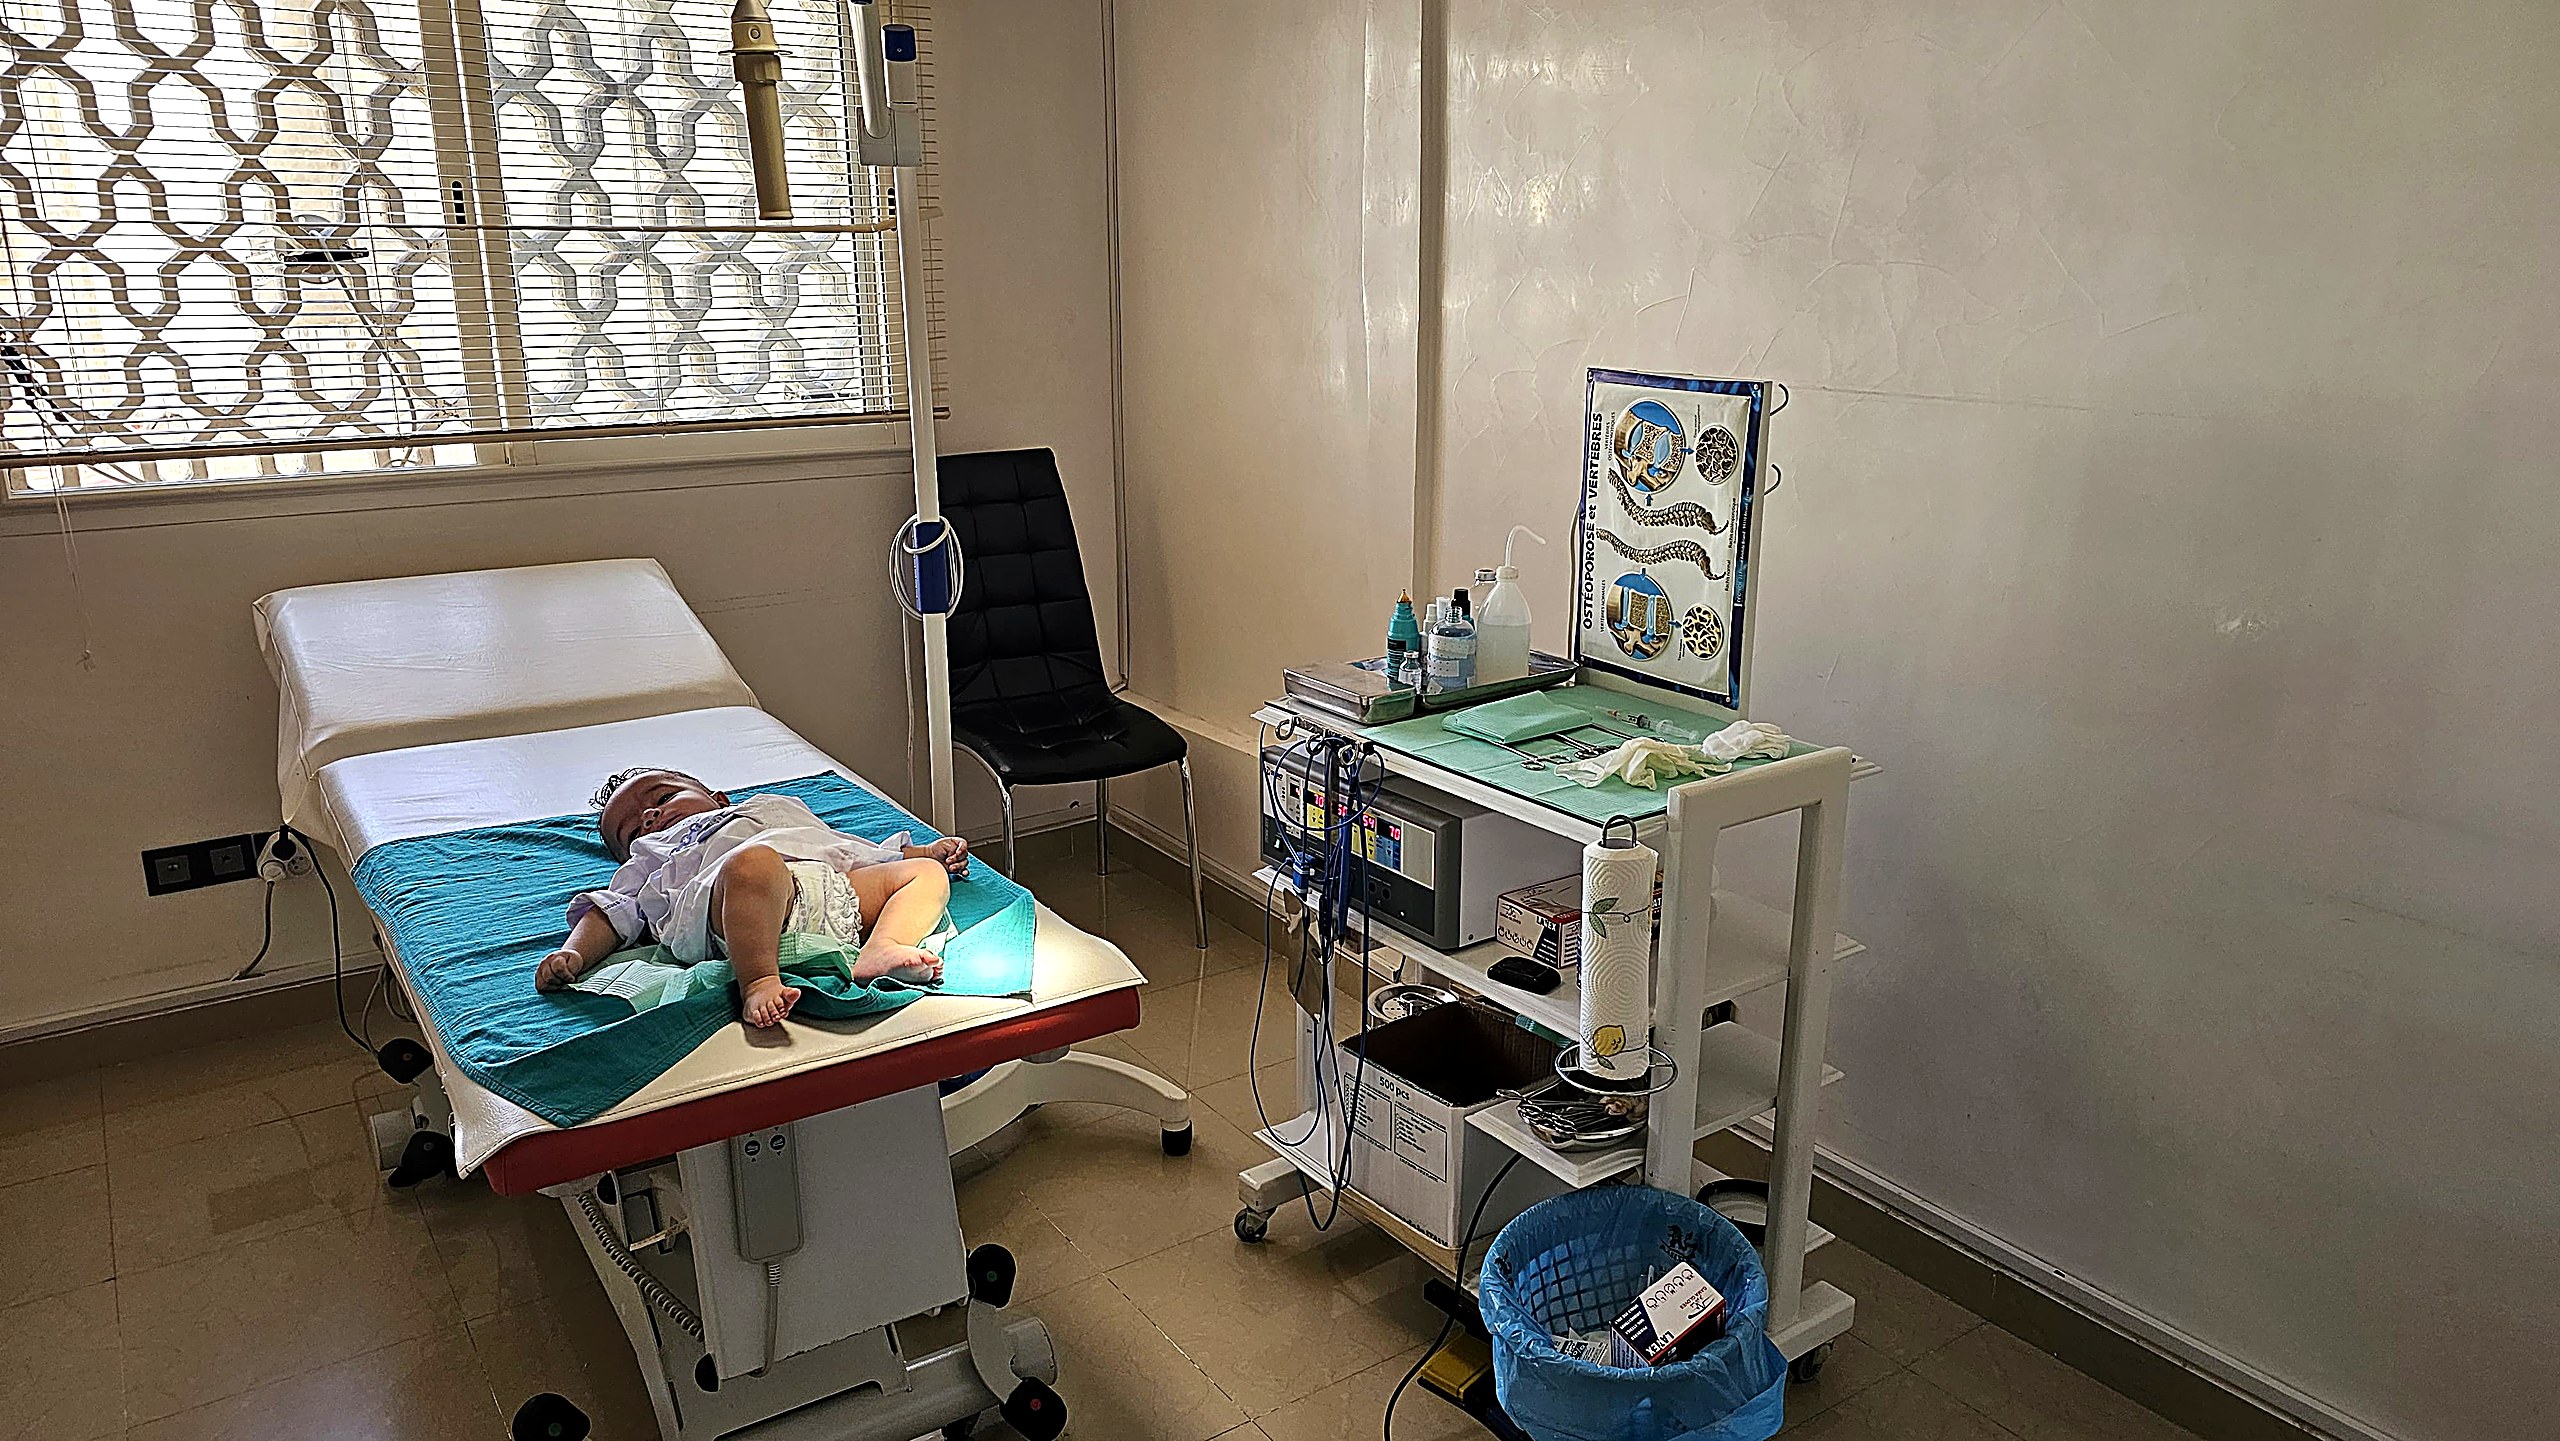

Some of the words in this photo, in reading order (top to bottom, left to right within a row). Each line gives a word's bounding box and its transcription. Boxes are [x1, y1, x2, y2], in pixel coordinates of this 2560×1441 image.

[1588, 412, 1603, 499] VERTÈBRES
[1588, 504, 1597, 519] et
[1582, 522, 1595, 629] OSTÉOPOROSE
[1362, 811, 1376, 828] 54
[1389, 825, 1401, 841] 70
[1536, 915, 1557, 932] LATEX
[1379, 1076, 1395, 1092] 500
[1395, 1085, 1410, 1101] pcs
[1646, 1330, 1675, 1357] LATEX
